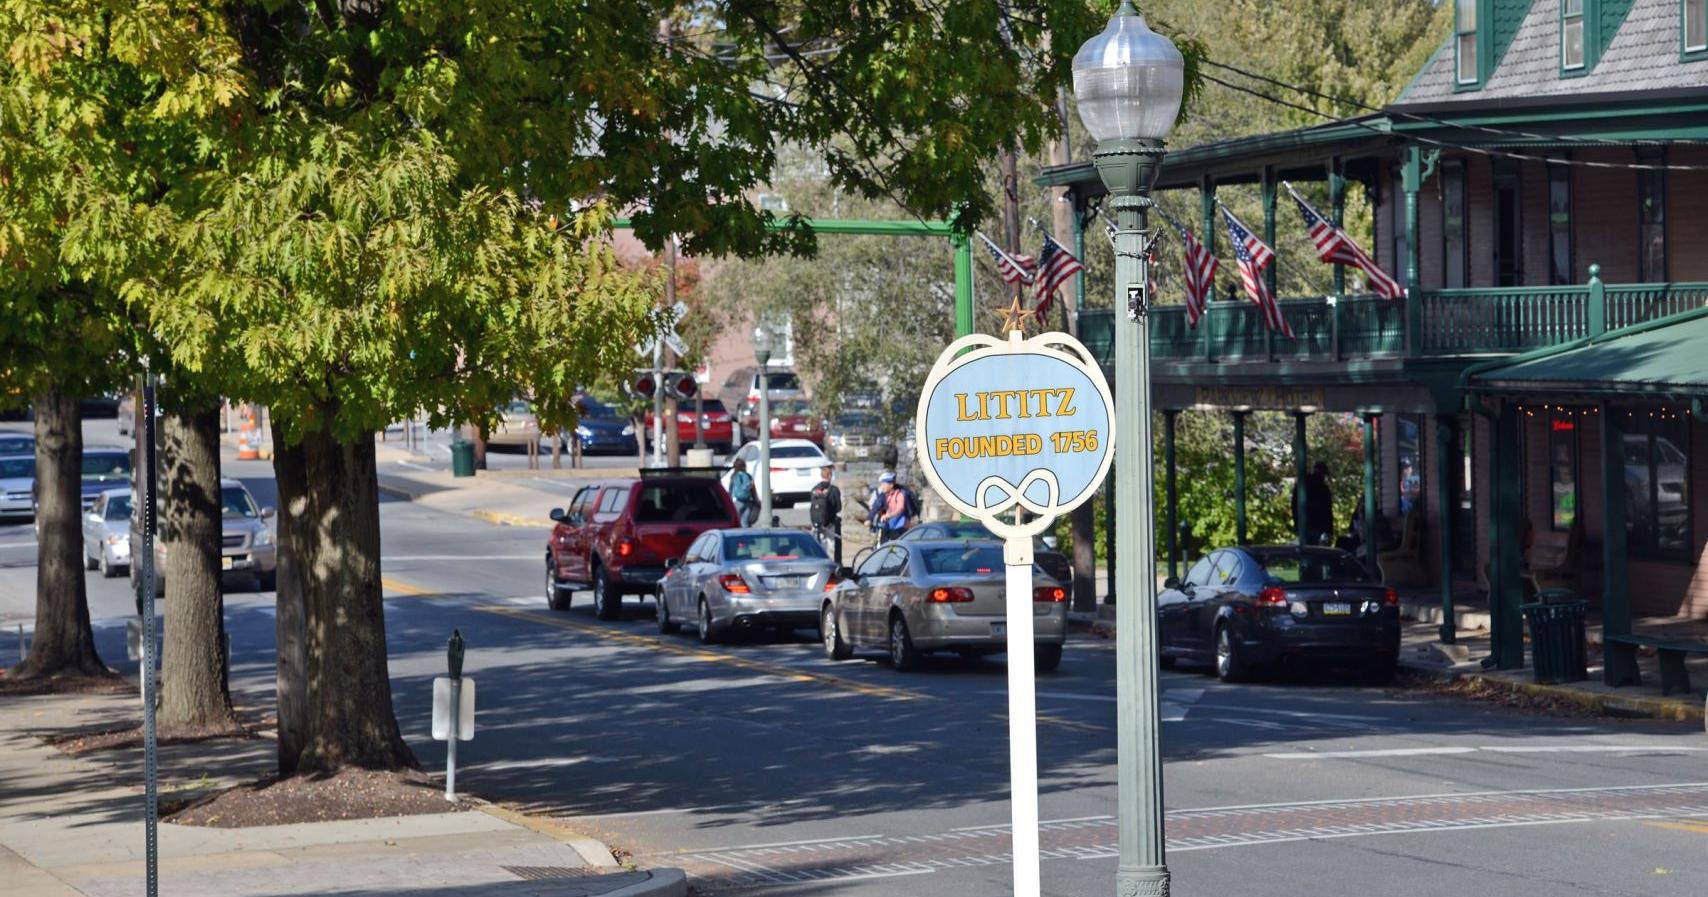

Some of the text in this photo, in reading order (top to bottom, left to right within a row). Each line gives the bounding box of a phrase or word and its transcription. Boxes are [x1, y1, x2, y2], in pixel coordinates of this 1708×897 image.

[954, 388, 1077, 422] LITITZ
[935, 429, 1098, 461] FOUNDED 1756
